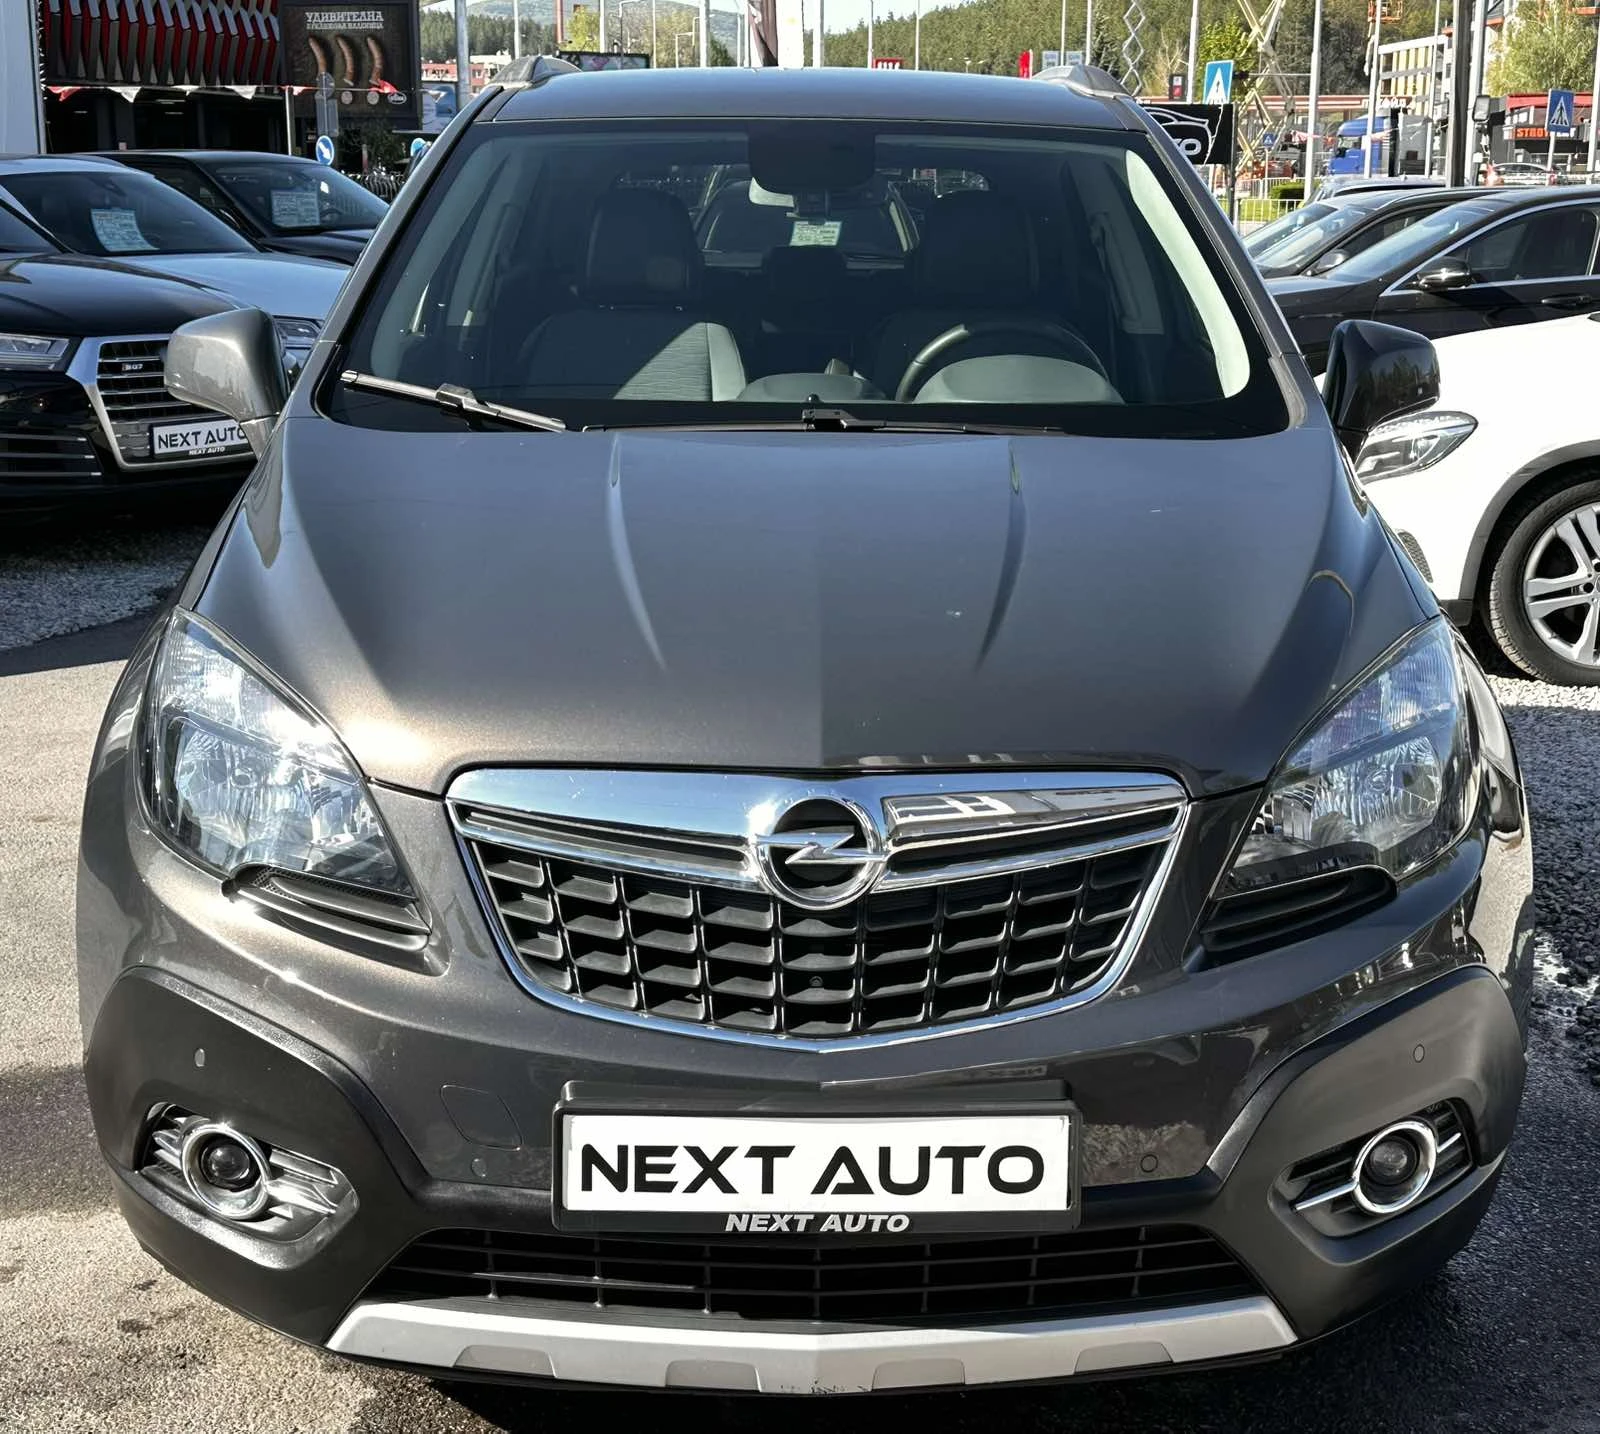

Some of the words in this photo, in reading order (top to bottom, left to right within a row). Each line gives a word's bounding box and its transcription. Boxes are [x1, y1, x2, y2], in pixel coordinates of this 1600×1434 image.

[157, 431, 202, 449] NEXT
[188, 447, 206, 456] NEXT
[207, 446, 226, 454] AUTO
[580, 1143, 797, 1195] NEXT
[810, 1144, 1045, 1196] AUTO
[725, 1213, 815, 1233] NEXT
[819, 1213, 911, 1233] AUTO
